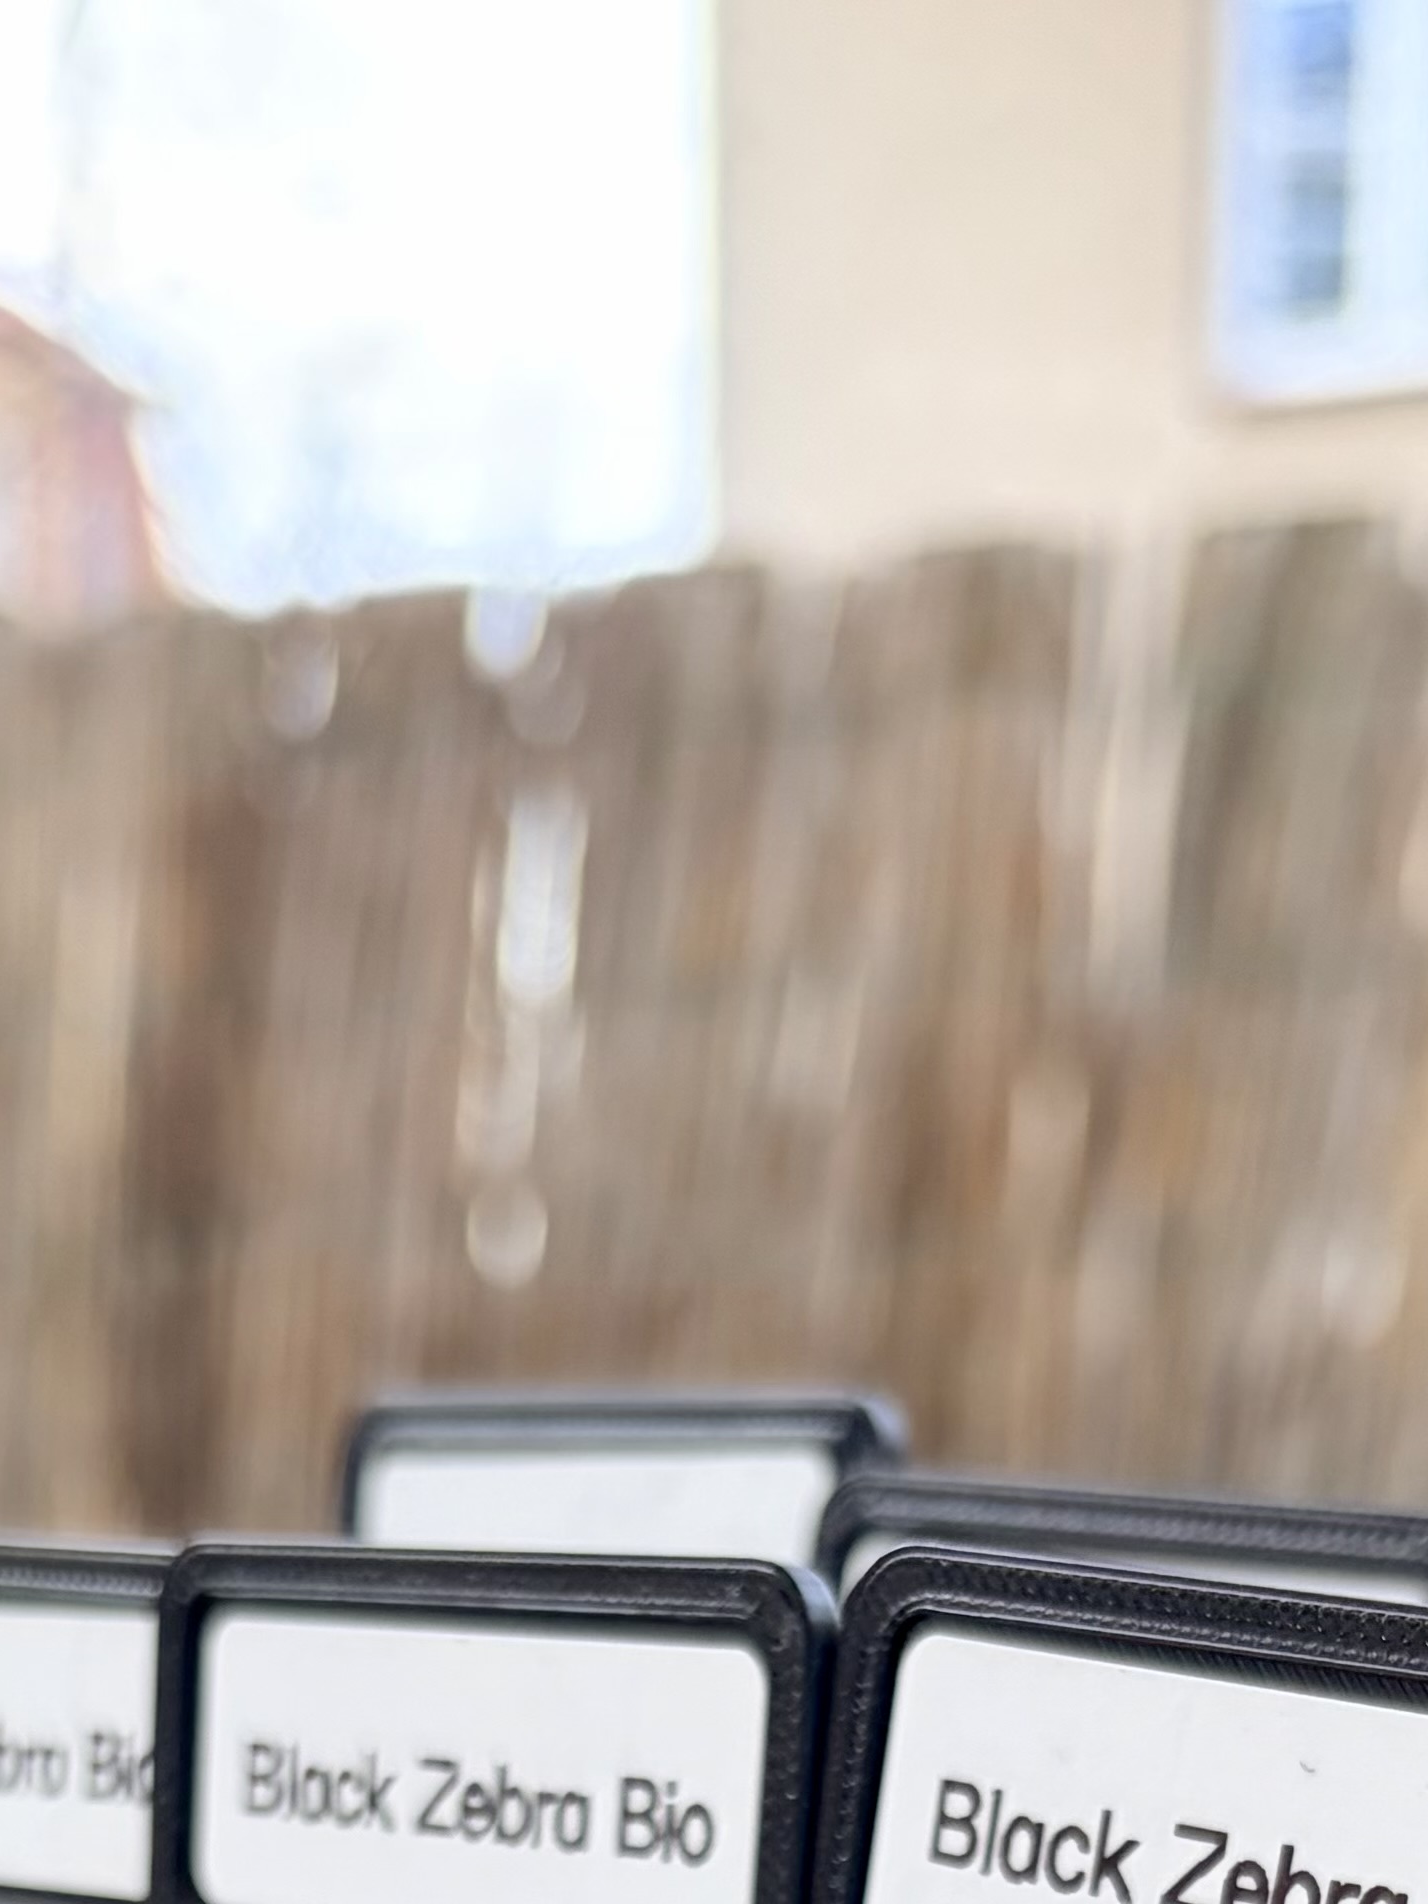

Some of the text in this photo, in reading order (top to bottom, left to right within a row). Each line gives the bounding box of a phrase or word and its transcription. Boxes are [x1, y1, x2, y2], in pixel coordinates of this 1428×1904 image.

[244, 1741, 716, 1867] Black Zebra Bio
